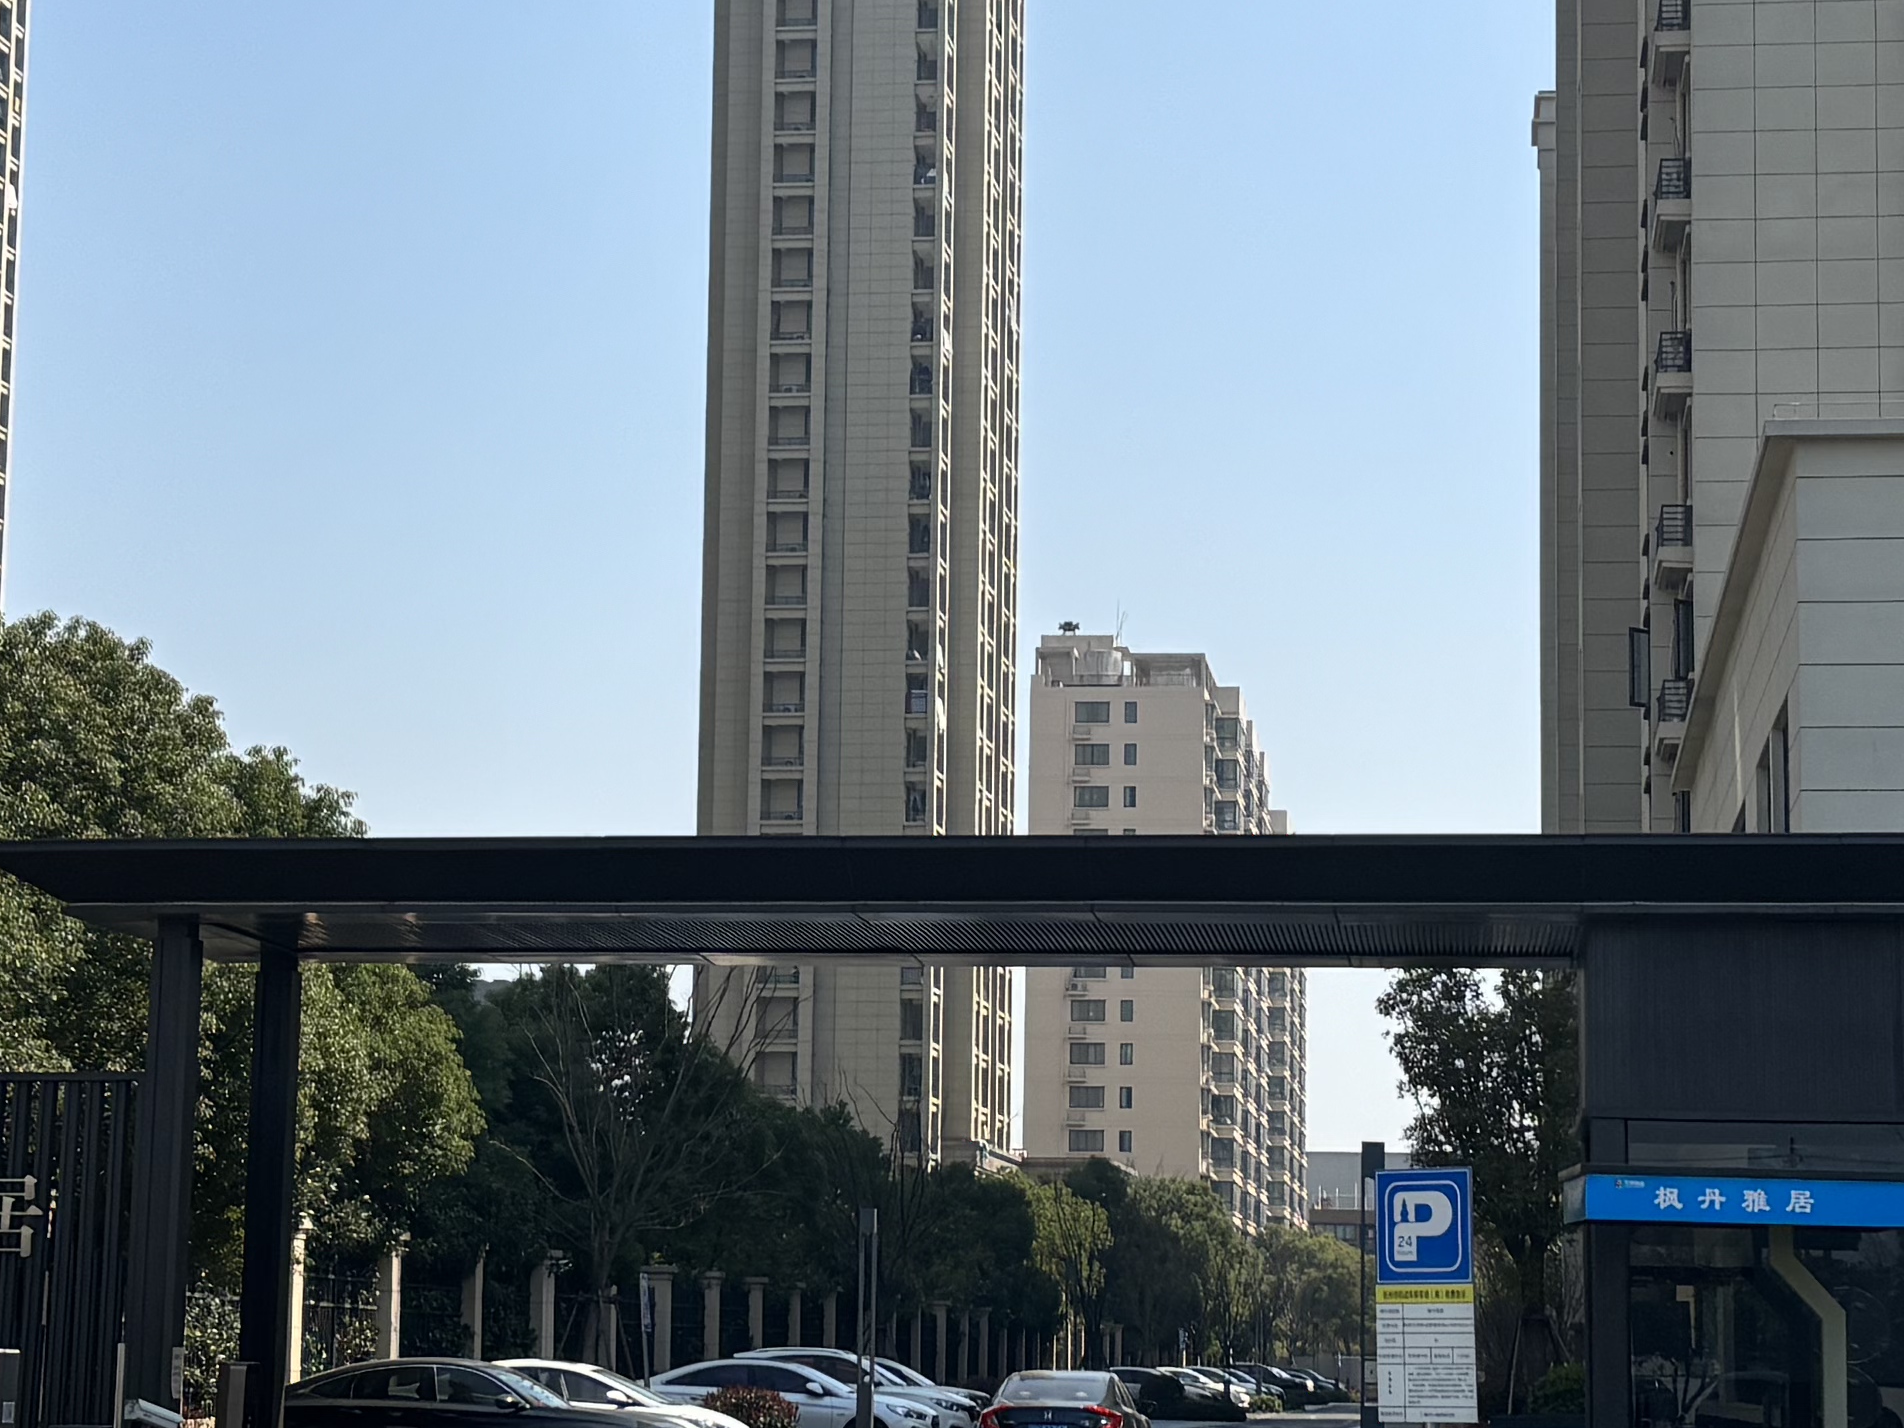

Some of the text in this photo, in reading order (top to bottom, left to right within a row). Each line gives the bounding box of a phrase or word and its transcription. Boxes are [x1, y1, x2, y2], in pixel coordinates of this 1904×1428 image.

[1654, 1186, 1815, 1214] 枫丹雅居
[1393, 1190, 1453, 1262] P
[1398, 1235, 1413, 1248] 24
